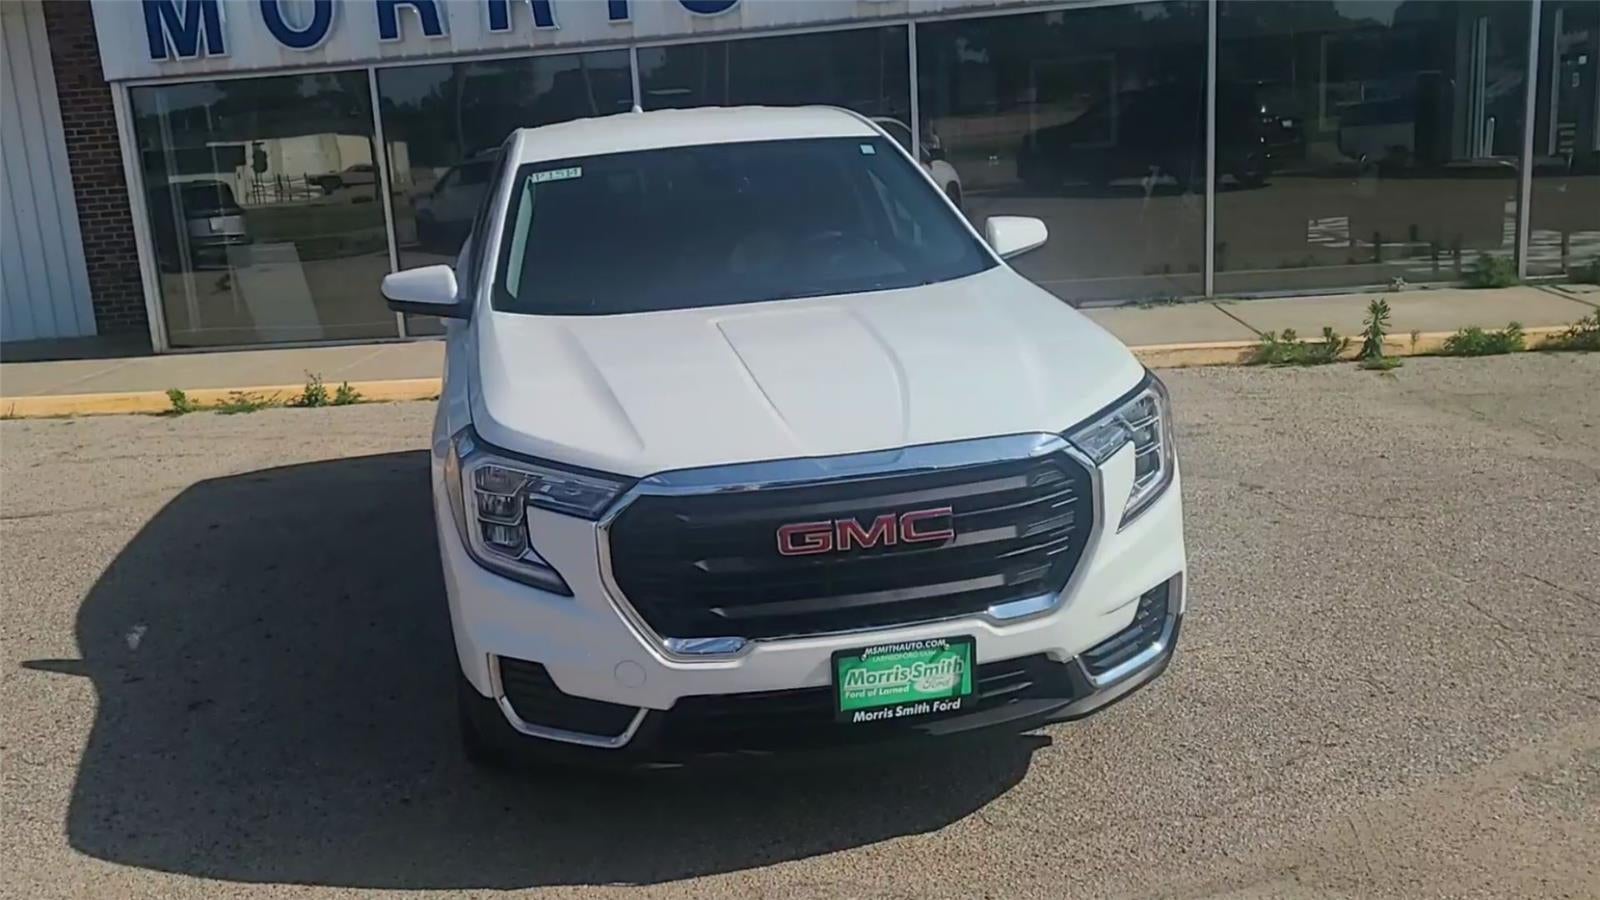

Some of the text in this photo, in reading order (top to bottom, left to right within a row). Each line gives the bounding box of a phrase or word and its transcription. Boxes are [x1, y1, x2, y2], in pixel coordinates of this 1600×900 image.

[777, 506, 954, 556] GMC
[865, 639, 946, 656] MSMITHAUTO.COM
[846, 665, 909, 686] Morris
[912, 656, 963, 679] Smith
[853, 698, 961, 723] Morris Smith Ford
